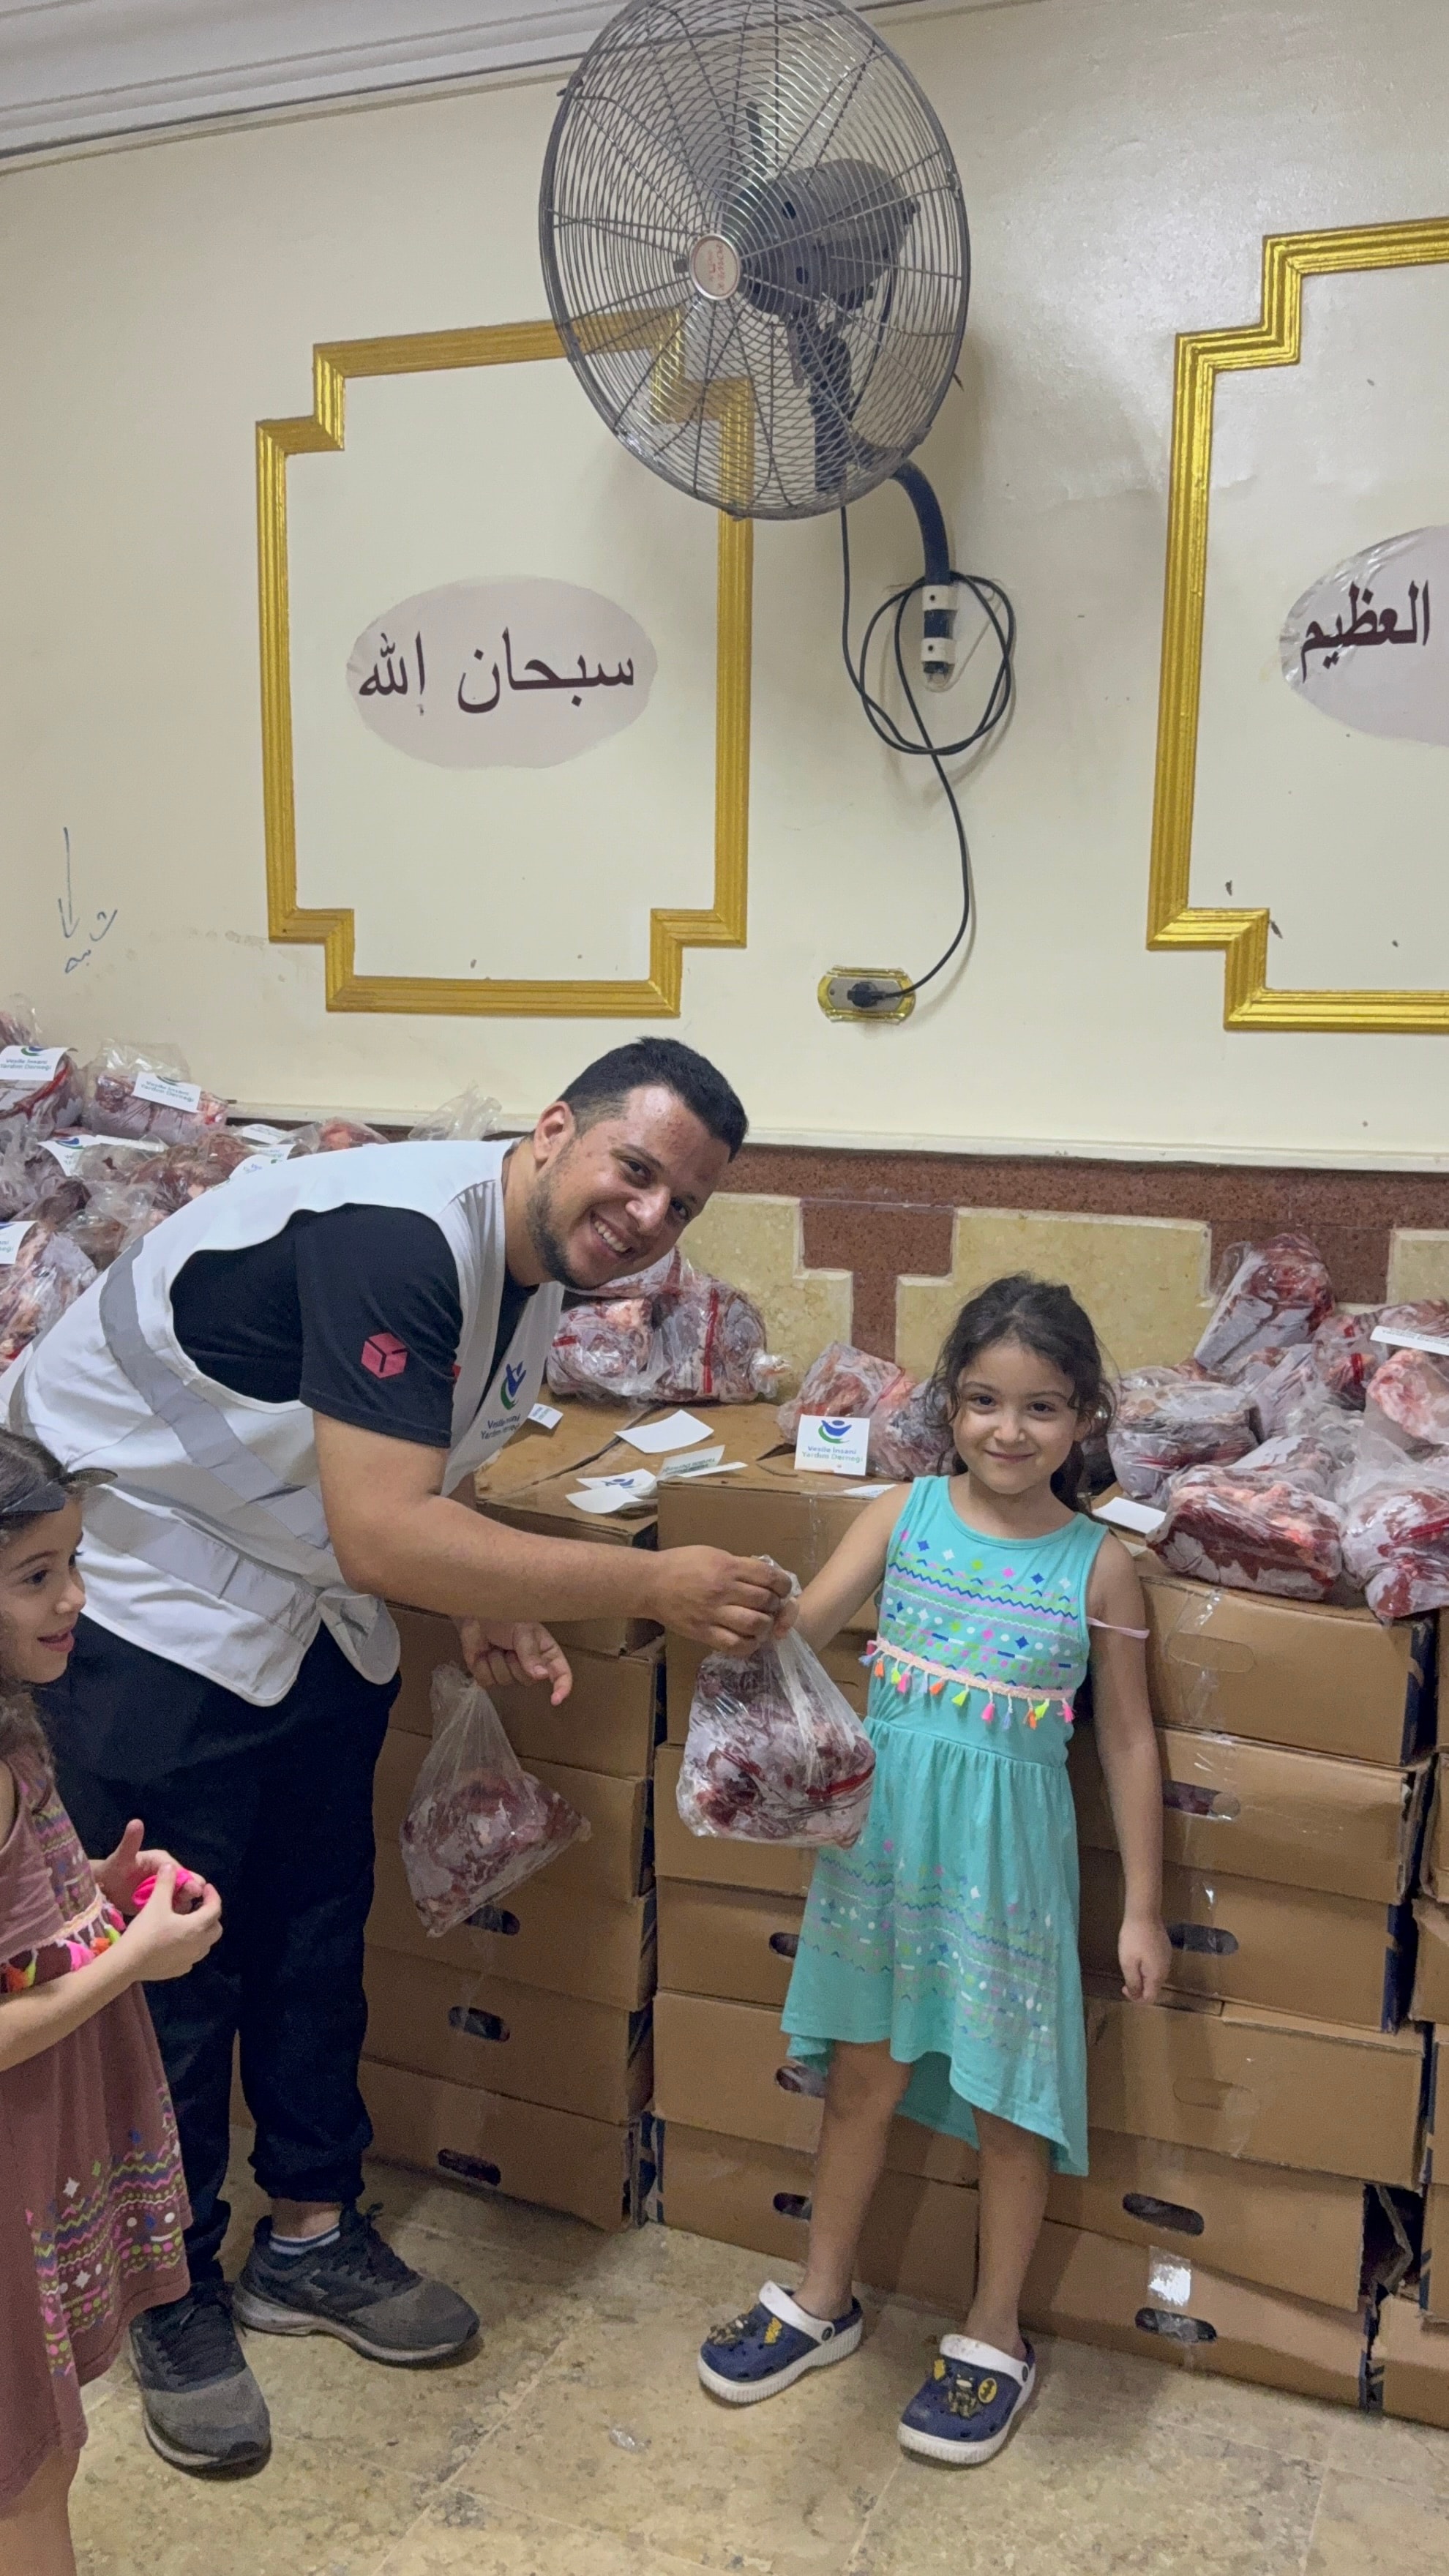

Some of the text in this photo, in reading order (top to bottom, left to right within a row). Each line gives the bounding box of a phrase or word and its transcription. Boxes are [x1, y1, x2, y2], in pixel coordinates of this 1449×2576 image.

[359, 626, 634, 714] سبحان الله
[1300, 579, 1431, 684] العظيم
